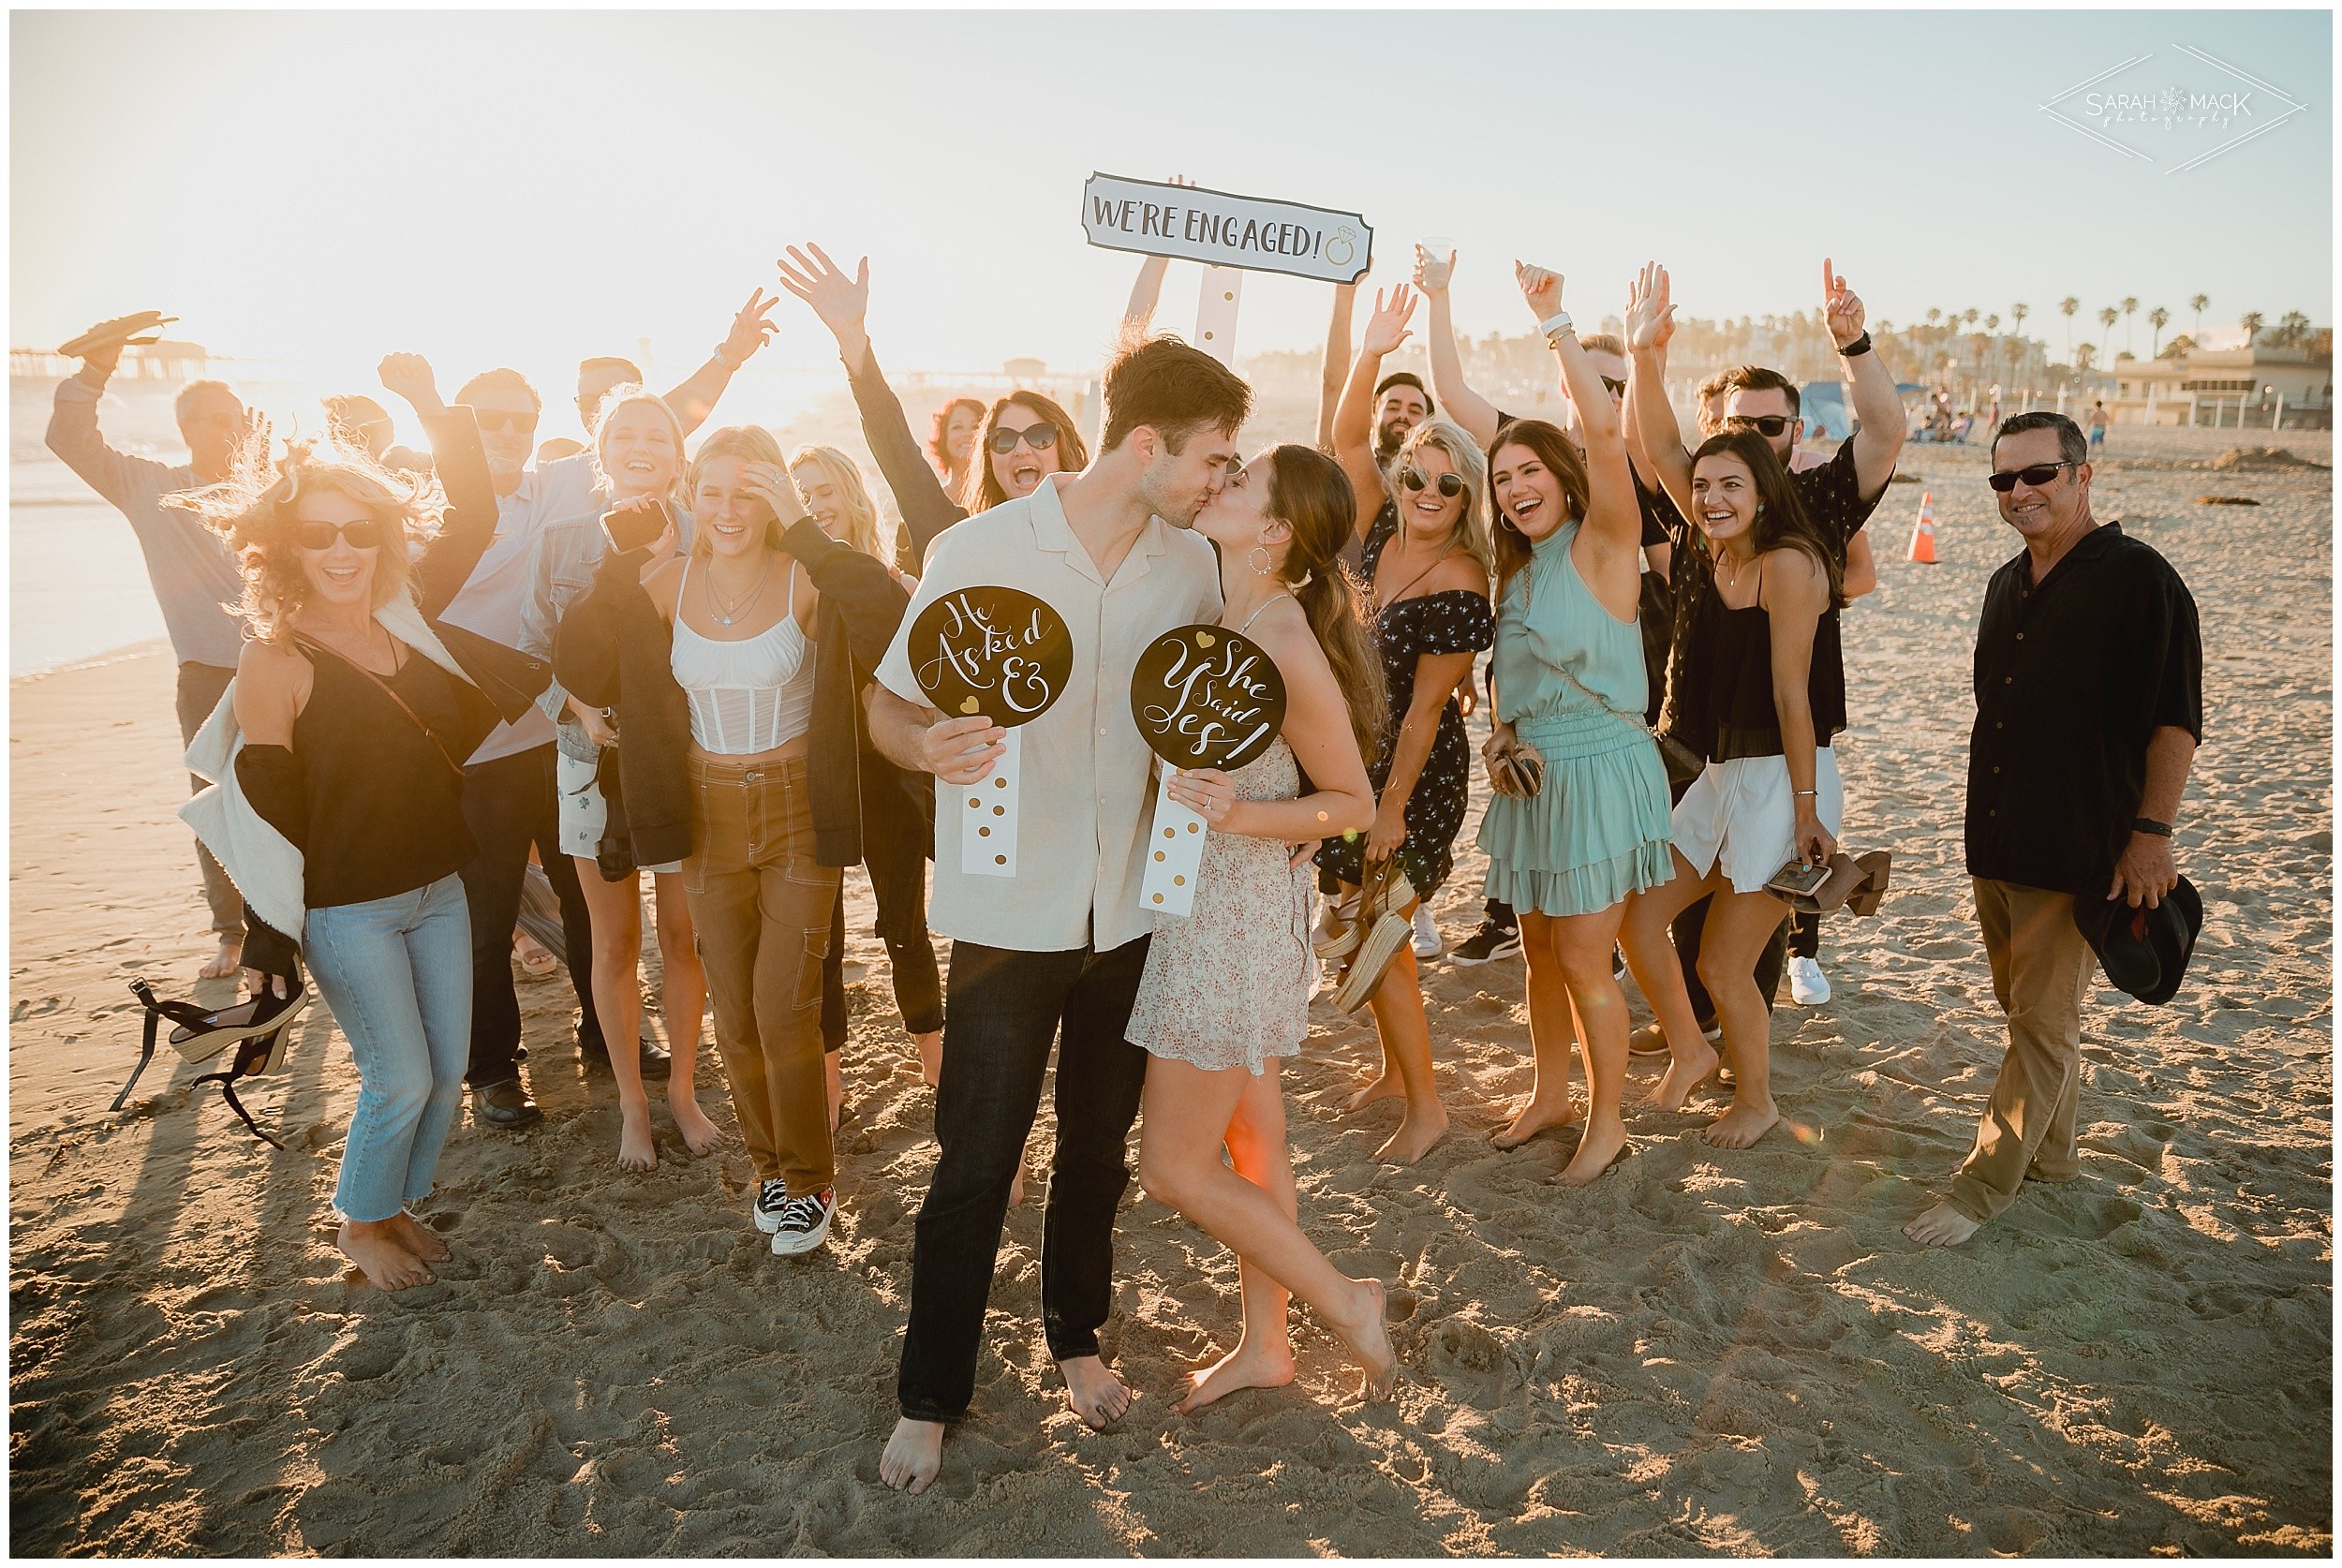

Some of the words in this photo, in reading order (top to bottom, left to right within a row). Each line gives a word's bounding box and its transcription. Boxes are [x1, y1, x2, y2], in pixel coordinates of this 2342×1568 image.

[1184, 208, 1322, 259] ENGAGED!
[943, 593, 1012, 639] He
[917, 607, 1053, 690] Asked
[1204, 639, 1274, 702] She
[1001, 656, 1050, 713] &
[1143, 638, 1270, 765] Yes!
[1192, 679, 1262, 726] Said
